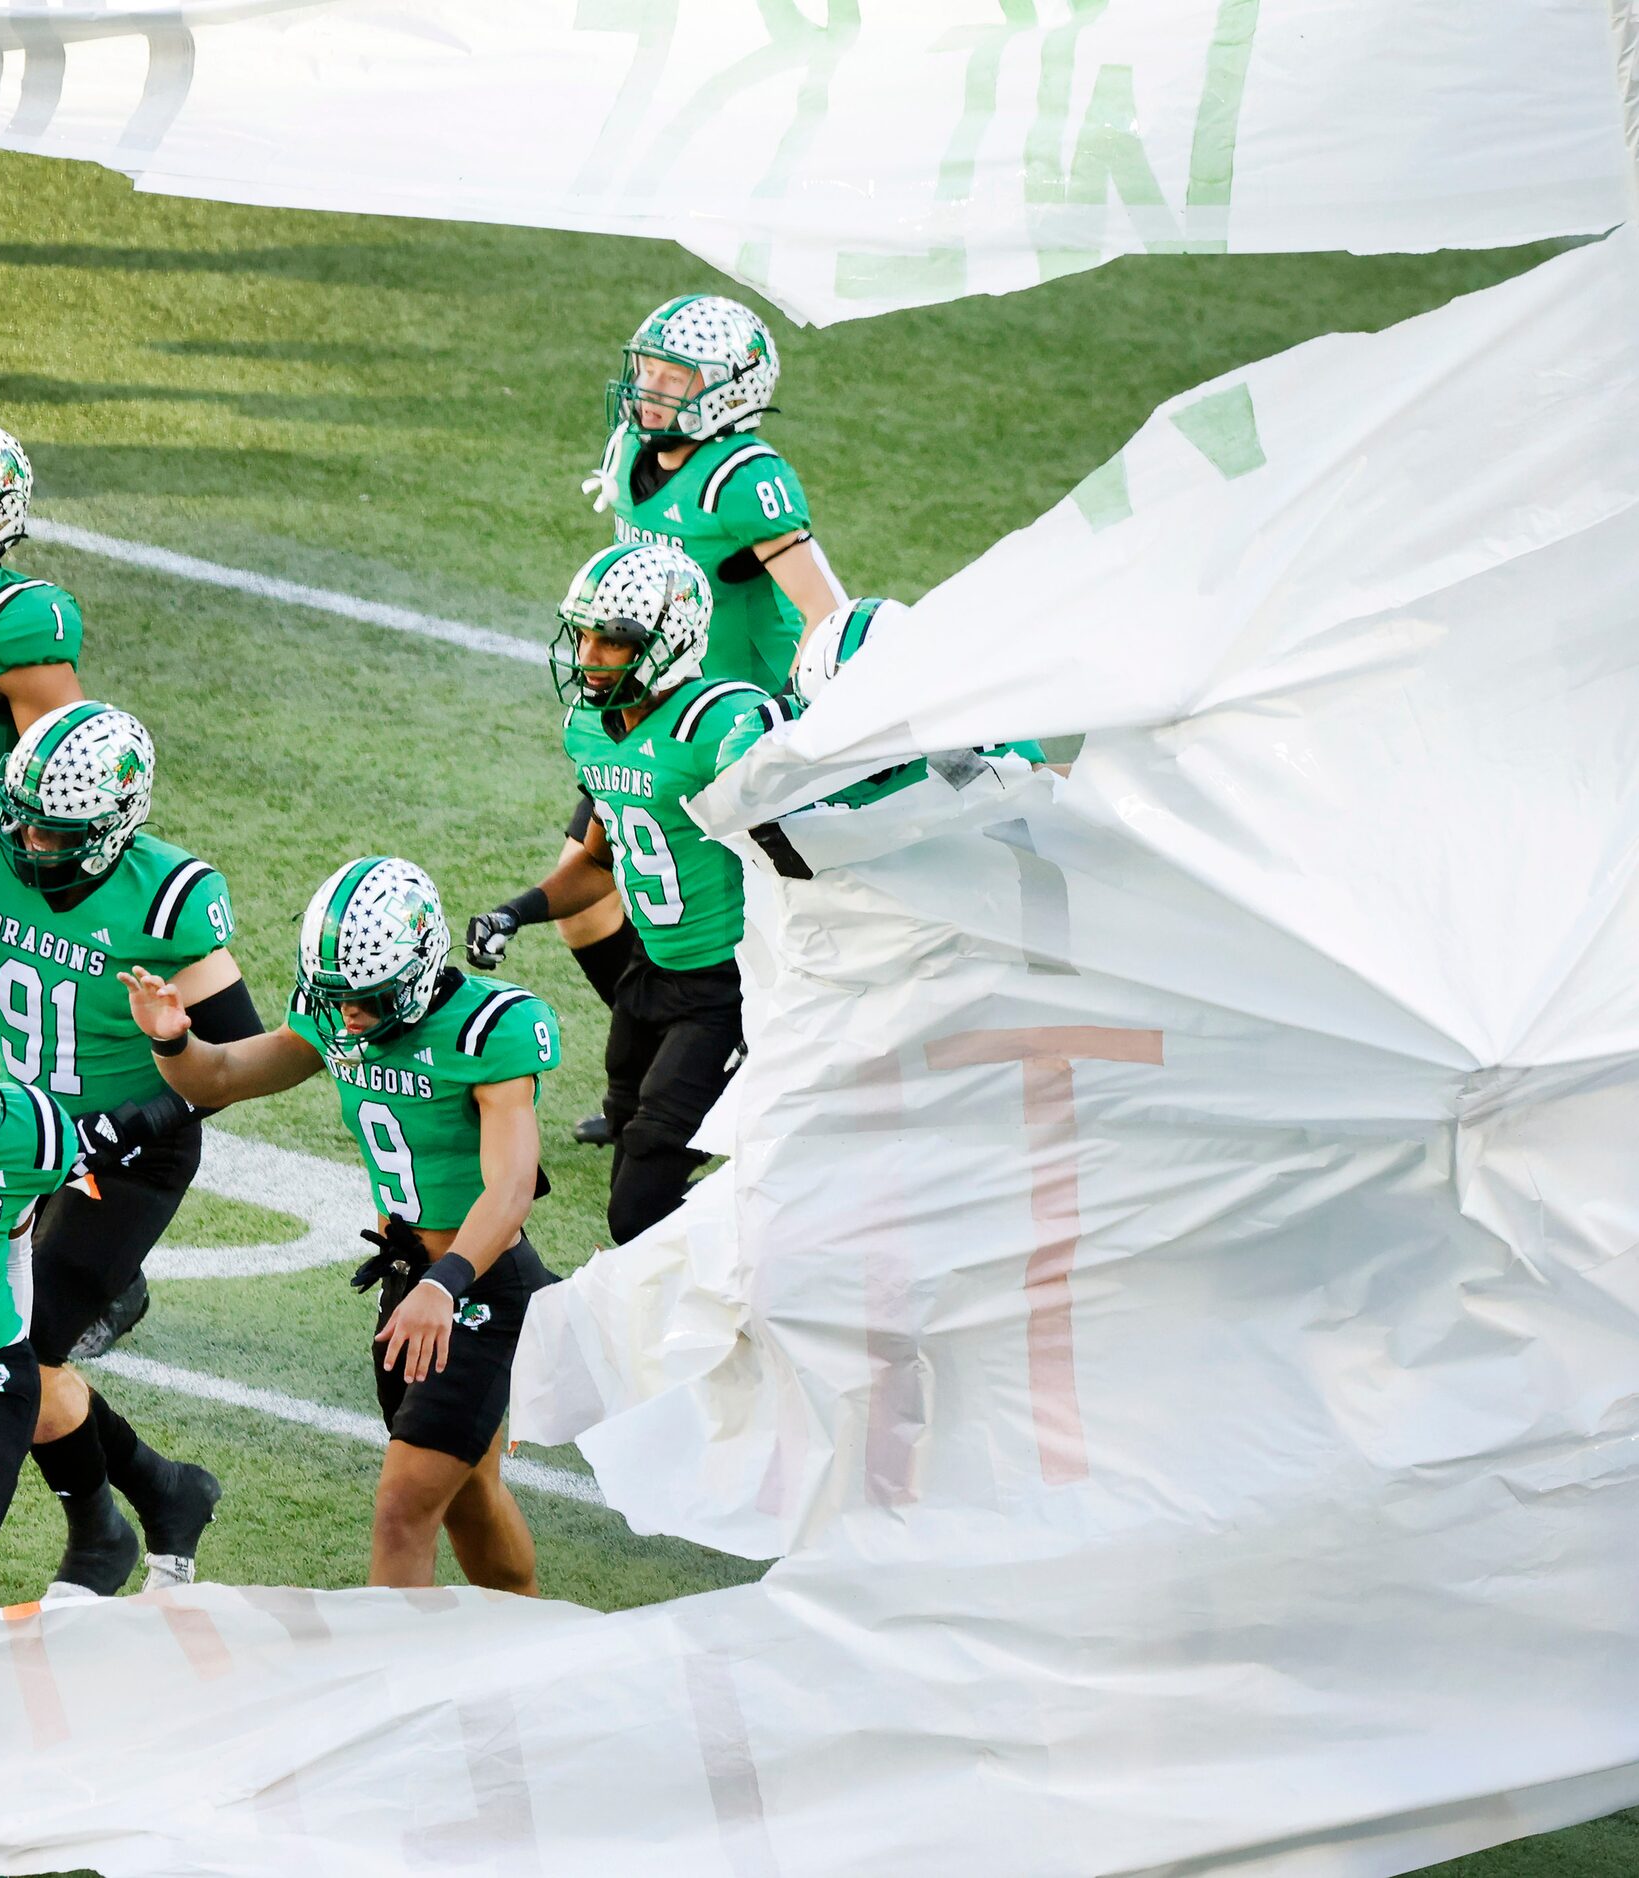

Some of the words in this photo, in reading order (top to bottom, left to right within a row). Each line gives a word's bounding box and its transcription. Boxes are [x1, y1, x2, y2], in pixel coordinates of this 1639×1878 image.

[755, 476, 793, 520] 81
[50, 602, 64, 641] 1
[581, 764, 653, 798] DRAGONS
[206, 895, 235, 943] 91
[533, 1021, 552, 1063] 9
[326, 1054, 433, 1099] DRAGONS
[357, 1099, 423, 1224] 9
